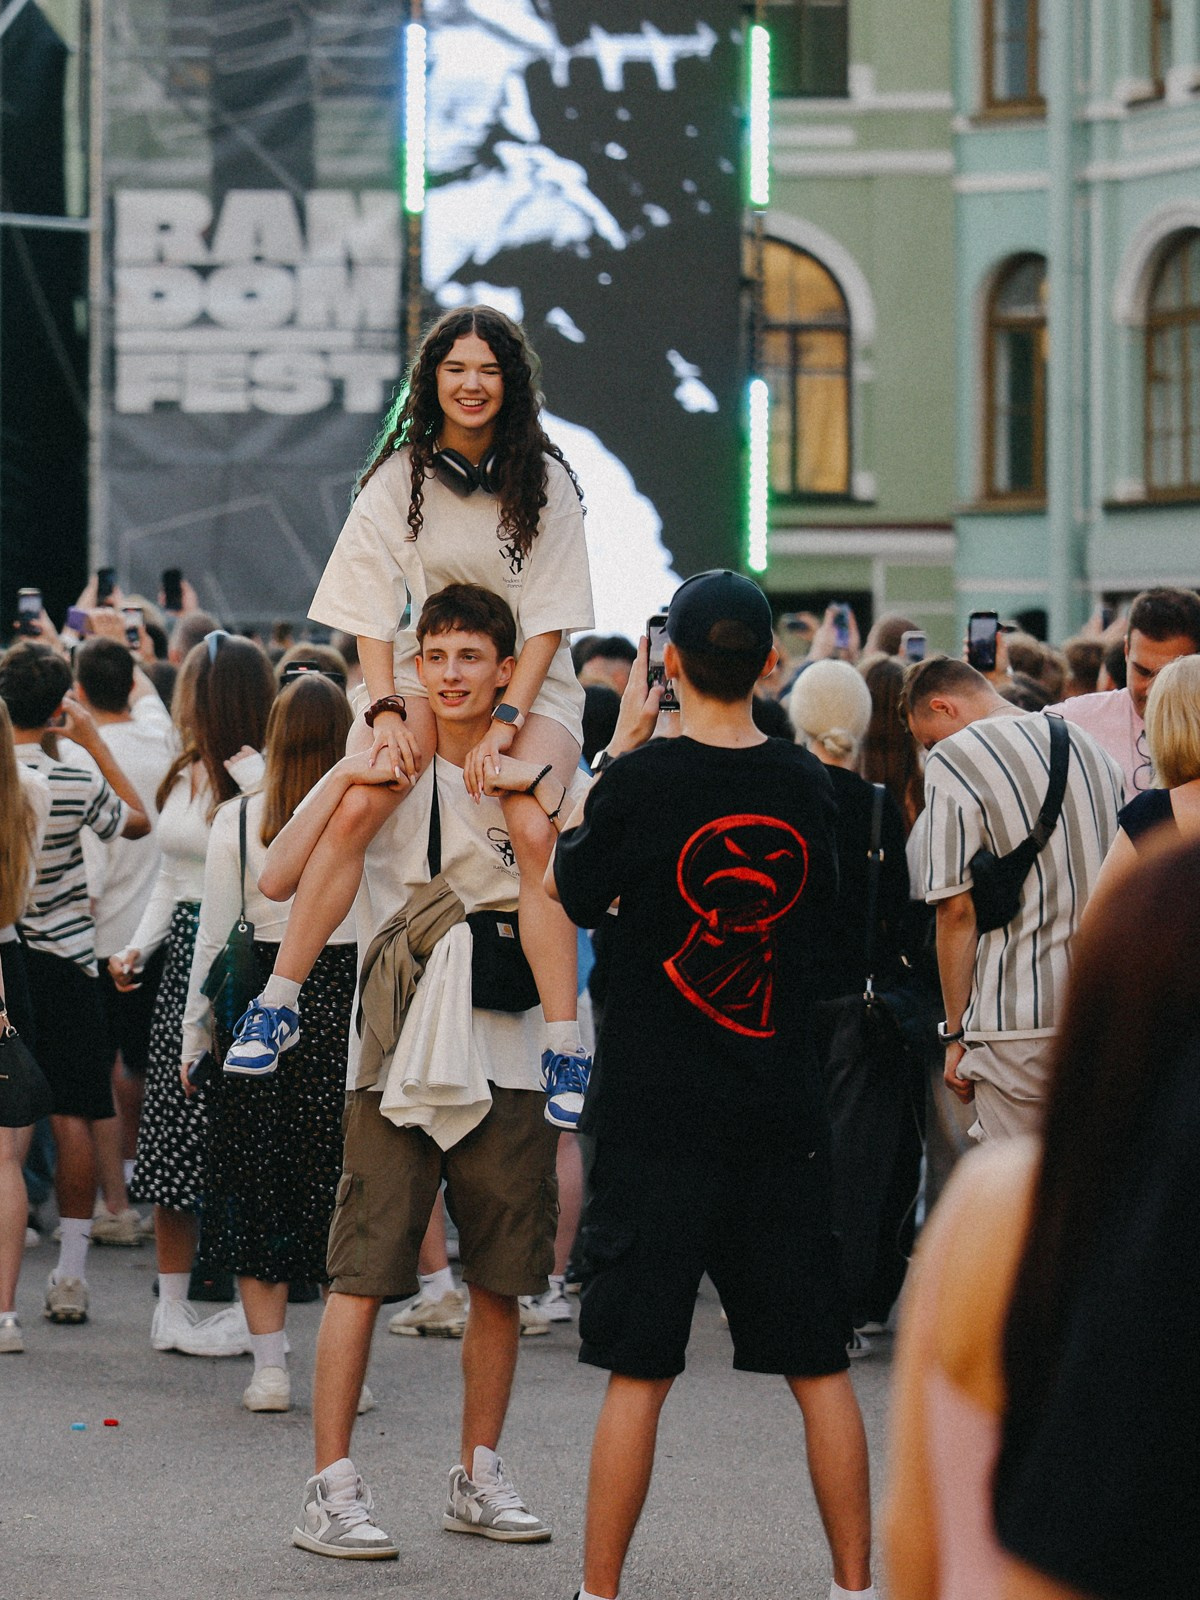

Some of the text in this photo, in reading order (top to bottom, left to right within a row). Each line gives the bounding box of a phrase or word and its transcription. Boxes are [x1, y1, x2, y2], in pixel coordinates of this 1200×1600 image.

[114, 188, 401, 262] RAM
[114, 264, 400, 329] DOM
[114, 351, 399, 414] FEST
